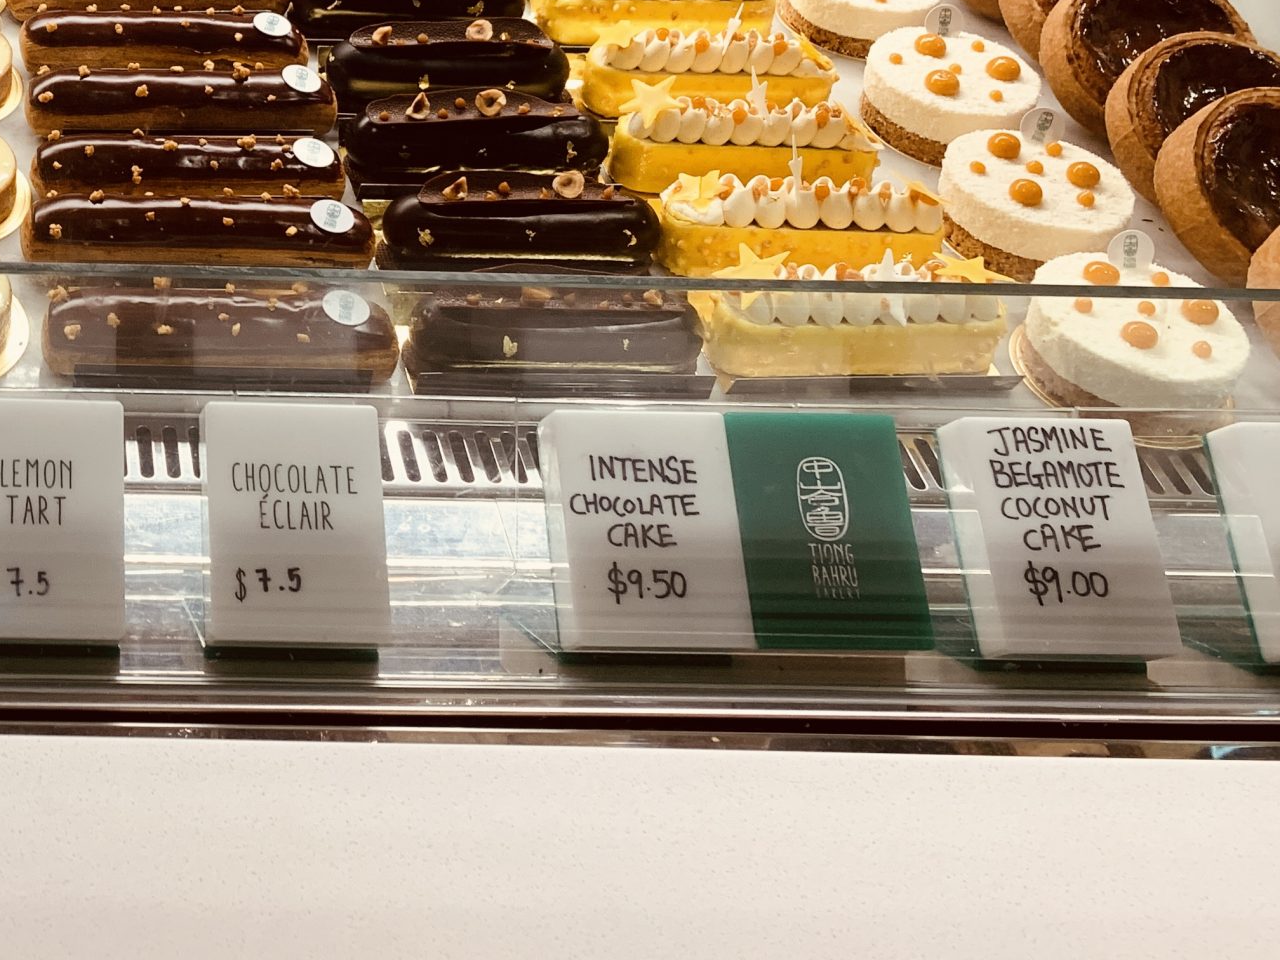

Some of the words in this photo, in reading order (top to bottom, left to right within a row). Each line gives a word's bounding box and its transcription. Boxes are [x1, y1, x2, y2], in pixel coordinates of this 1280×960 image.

[987, 426, 1113, 457] JASMINE
[0, 458, 73, 491] LEMON
[231, 462, 358, 495] CHOCOLATE
[589, 454, 698, 485] INTENSE
[989, 460, 1126, 490] BEGAMOTE
[6, 495, 67, 526] TART
[259, 494, 334, 531] ÉCLAIR
[570, 493, 700, 518] CHOCOLATE
[1001, 495, 1111, 521] COCONUT
[607, 523, 677, 548] CAKE
[1022, 524, 1102, 553] CAKE
[808, 543, 855, 565] TIONG
[607, 561, 687, 604] $9.50
[812, 565, 859, 587] BAHRU
[1024, 561, 1110, 607] $9.00
